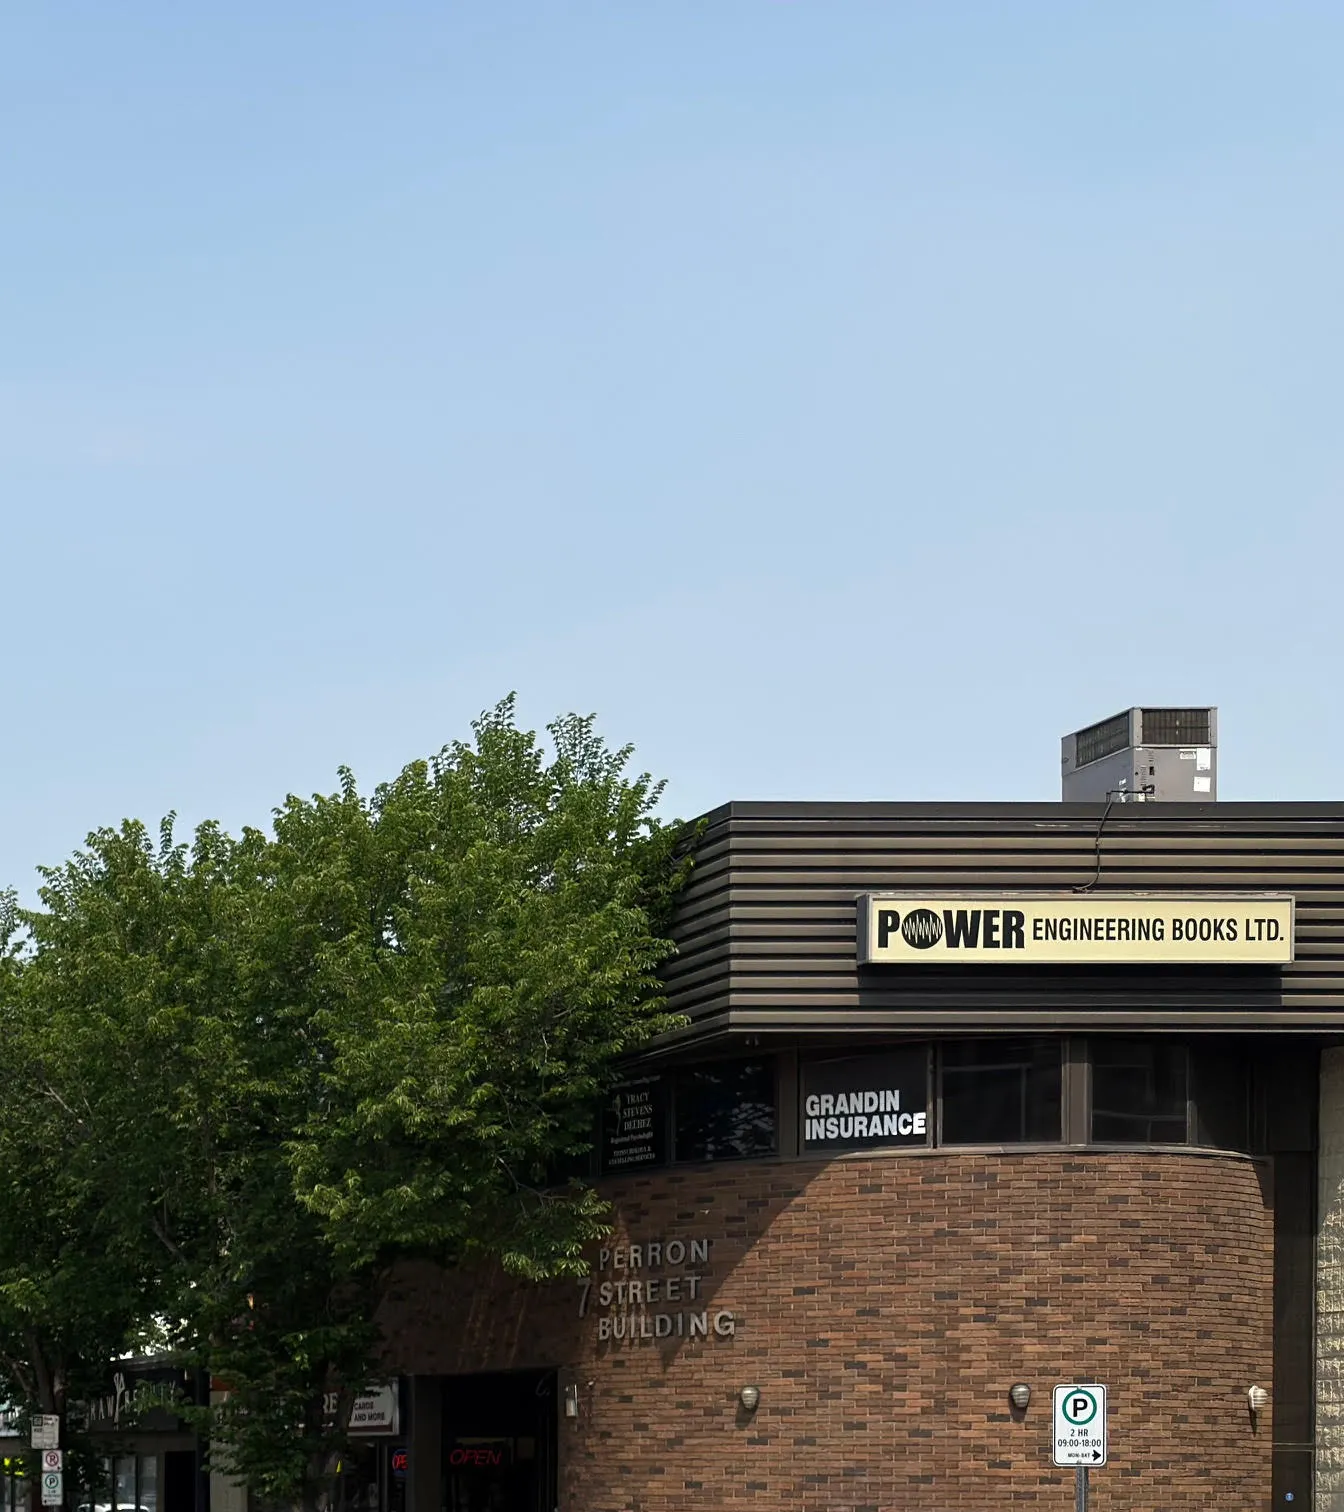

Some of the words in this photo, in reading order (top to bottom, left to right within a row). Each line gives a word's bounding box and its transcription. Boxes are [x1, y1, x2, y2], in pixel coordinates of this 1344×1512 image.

[878, 908, 1025, 950] POWER
[1032, 917, 1164, 941] ENGINEERING
[1172, 917, 1238, 941] BOOKS
[1245, 918, 1284, 941] LTD.
[805, 1089, 900, 1117] GRANDIN
[805, 1112, 927, 1140] INSURANCE
[599, 1239, 708, 1271] PERRON
[599, 1276, 702, 1306] STREET
[598, 1310, 735, 1340] BUILDING
[354, 1412, 366, 1421] AND
[368, 1412, 385, 1421] MORE
[1073, 1398, 1088, 1417] P
[1057, 1439, 1102, 1447] 09:00-18:00
[1070, 1429, 1075, 1437] 2
[1078, 1429, 1089, 1437] HR
[449, 1448, 503, 1466] OPEN
